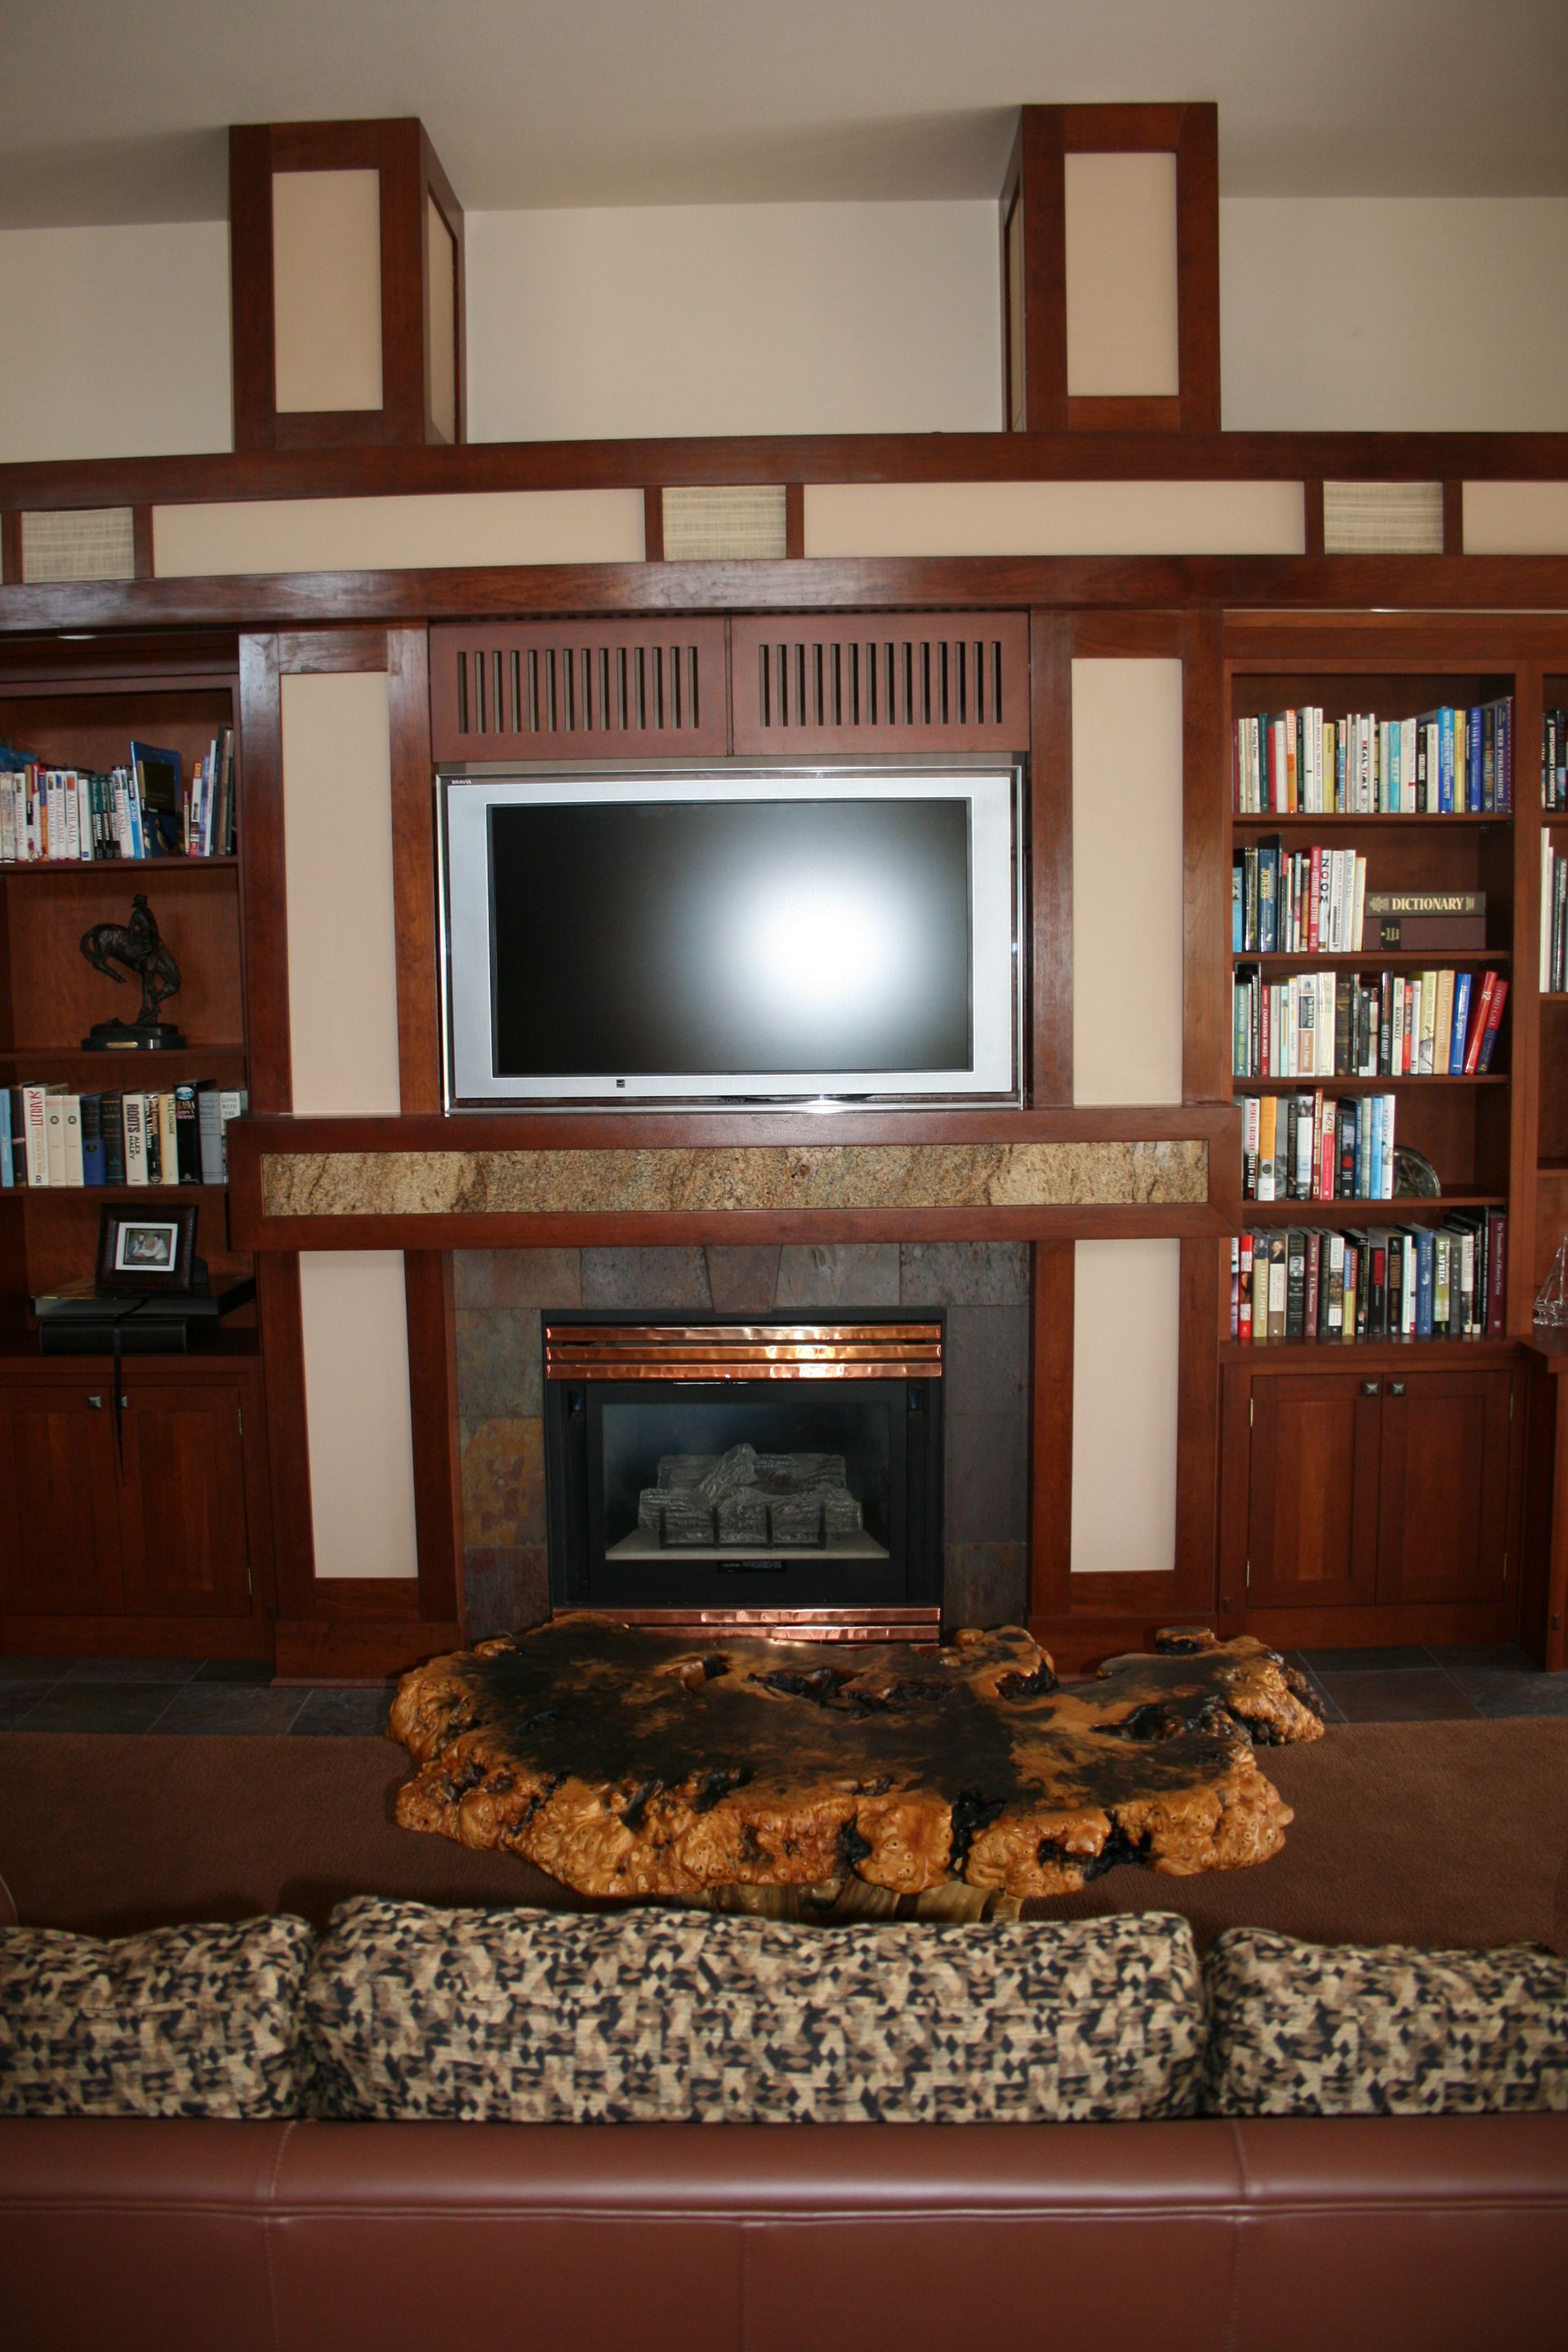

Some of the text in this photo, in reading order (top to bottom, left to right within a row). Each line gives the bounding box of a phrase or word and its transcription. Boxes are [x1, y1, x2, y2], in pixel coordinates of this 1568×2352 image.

[1484, 750, 1494, 773] Loyalty
[16, 793, 24, 847] CALIFORNIA
[68, 794, 77, 844] AUSTRALIA
[116, 793, 126, 835] IRELAND
[1261, 868, 1270, 899] JOKES
[1320, 858, 1330, 904] ZOOM
[1311, 898, 1319, 925] QUESTION
[1392, 898, 1464, 911] DICTIONARY
[1440, 998, 1450, 1043] Greenspan
[1489, 989, 1503, 1027] HARD CALL
[1381, 1052, 1388, 1061] UP
[28, 1091, 43, 1126] SCARLETT
[127, 1103, 140, 1133] ROOTS
[1325, 1112, 1334, 1131] 1421
[1248, 1153, 1256, 1169] STATE
[1248, 1175, 1256, 1188] FEAR
[1438, 1241, 1446, 1250] in
